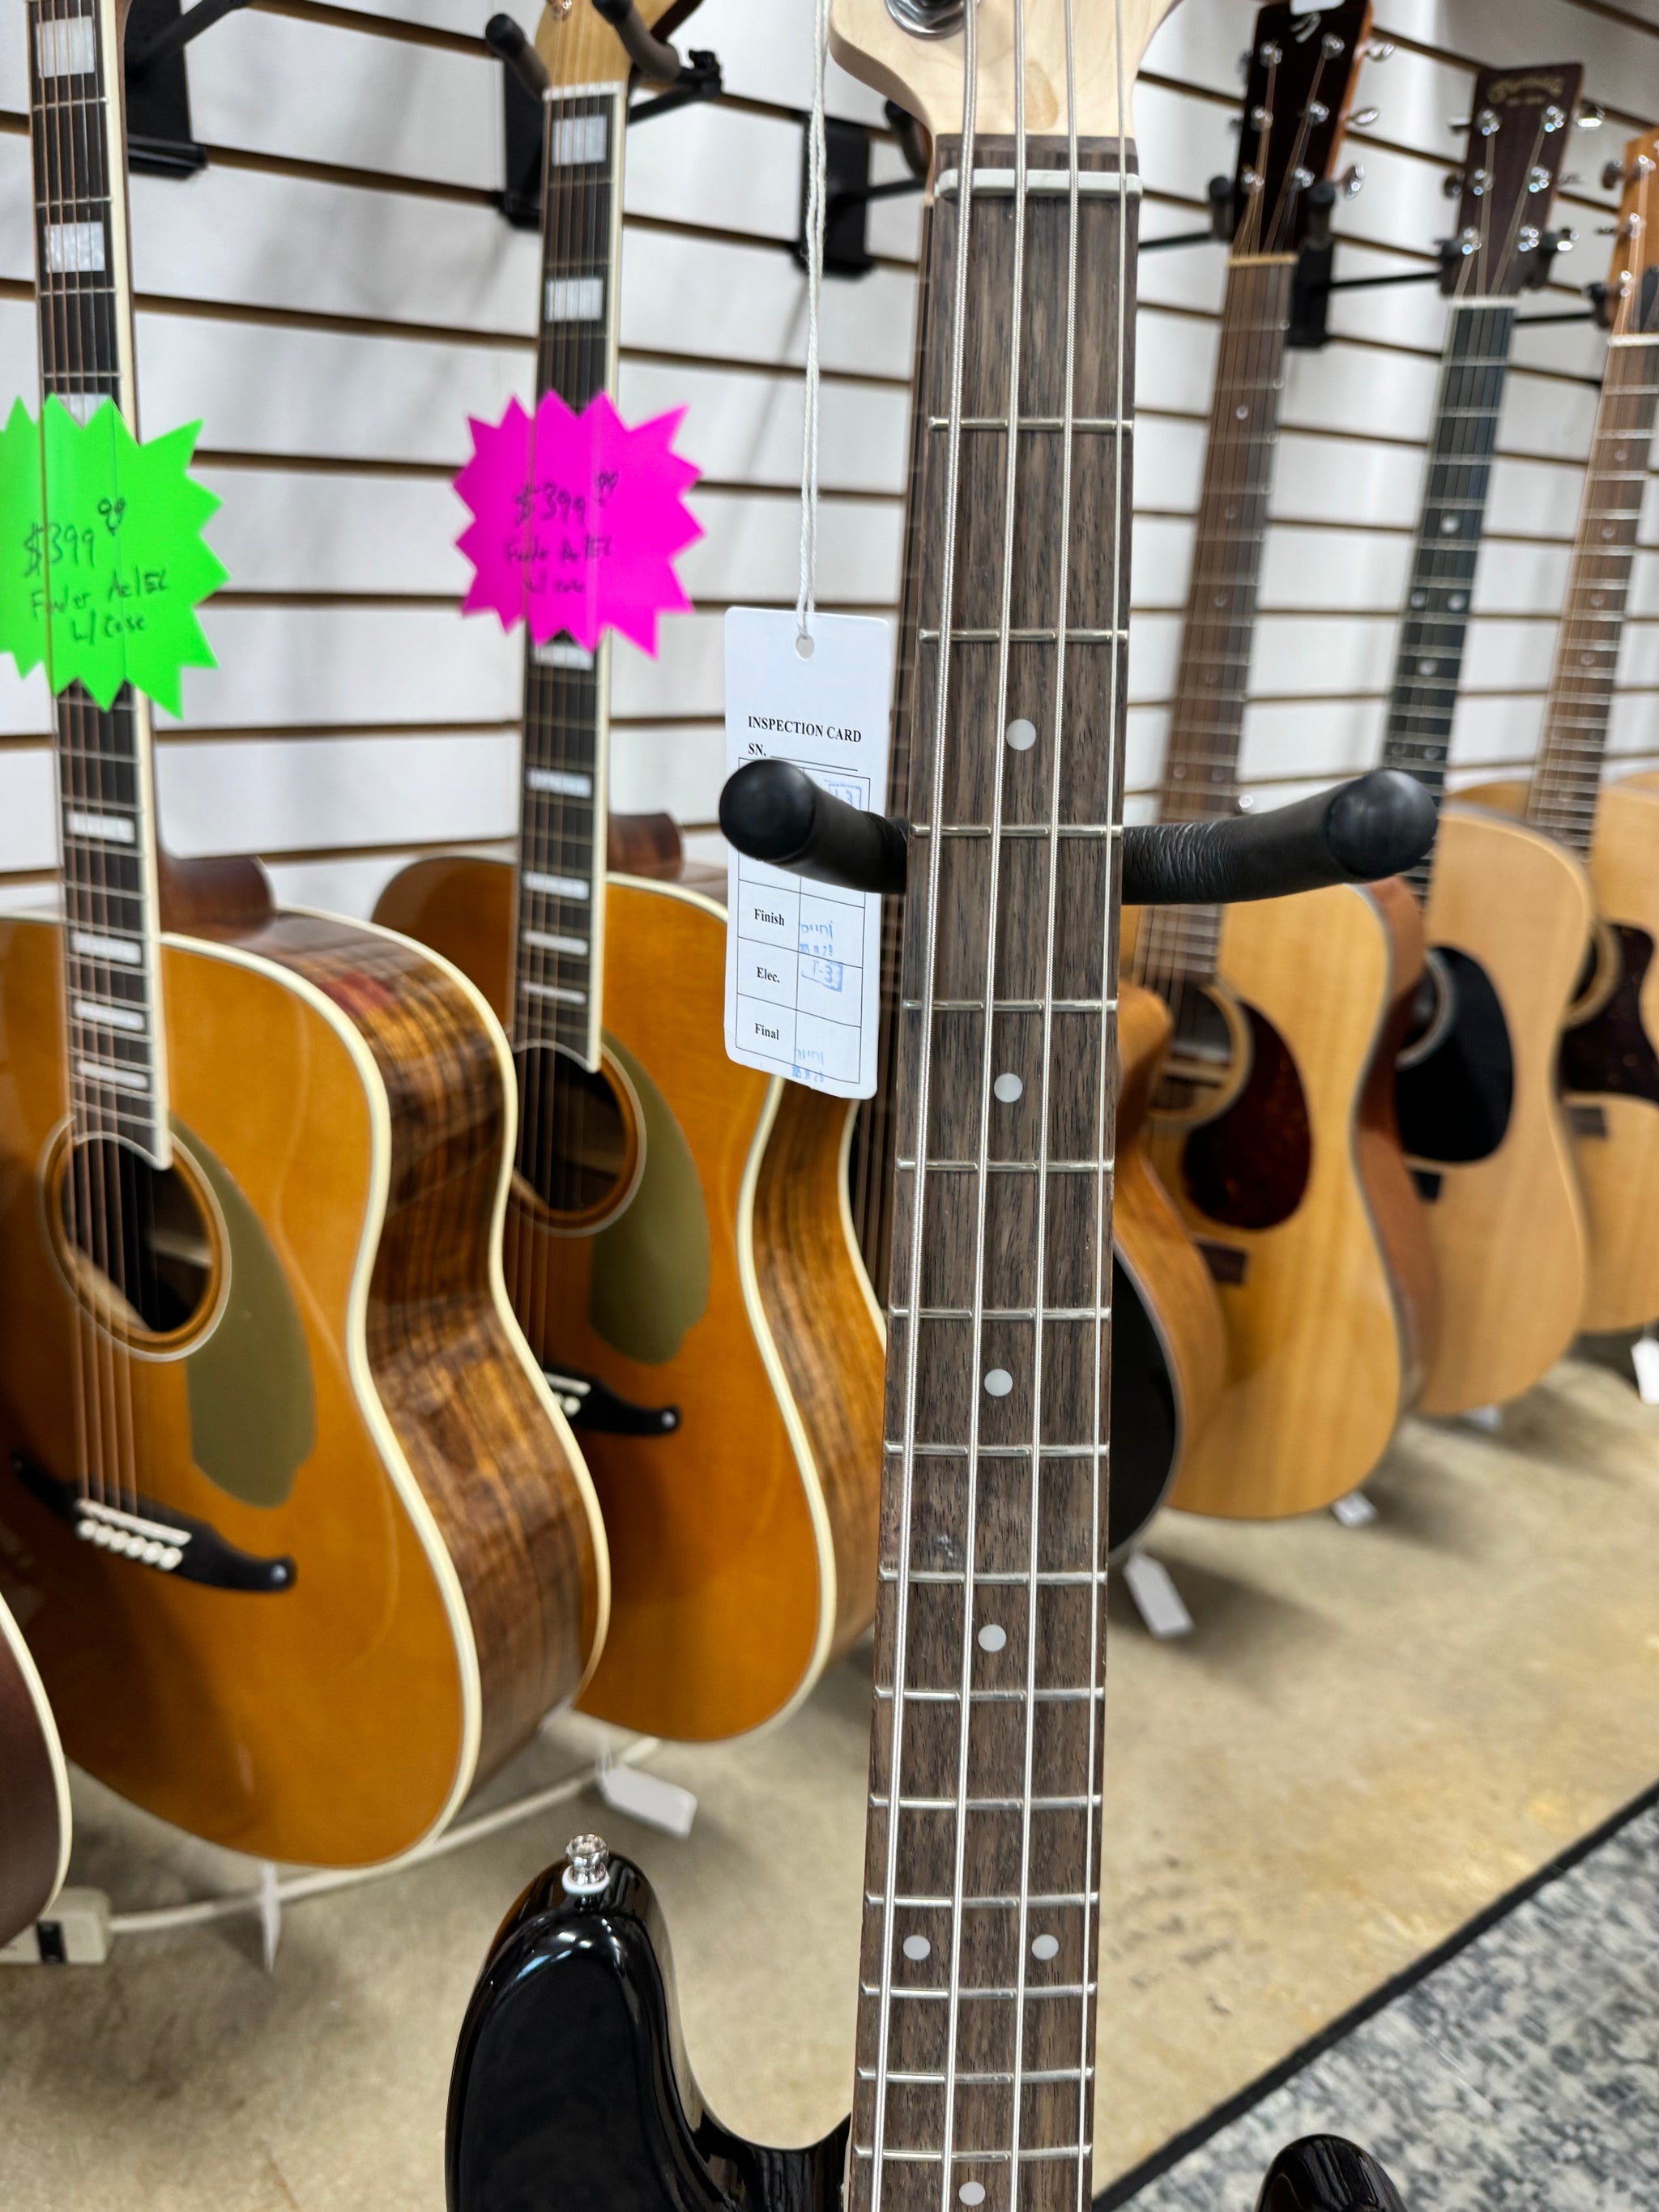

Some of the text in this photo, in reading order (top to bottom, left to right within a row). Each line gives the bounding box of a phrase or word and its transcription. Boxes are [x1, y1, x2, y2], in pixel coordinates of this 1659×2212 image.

[24, 521, 95, 578] $399
[748, 715, 863, 744] INSPECTION CARD
[748, 742, 766, 757] SN.
[754, 908, 785, 927] Finish
[757, 965, 781, 983] Elec.
[754, 1023, 780, 1041] Final
